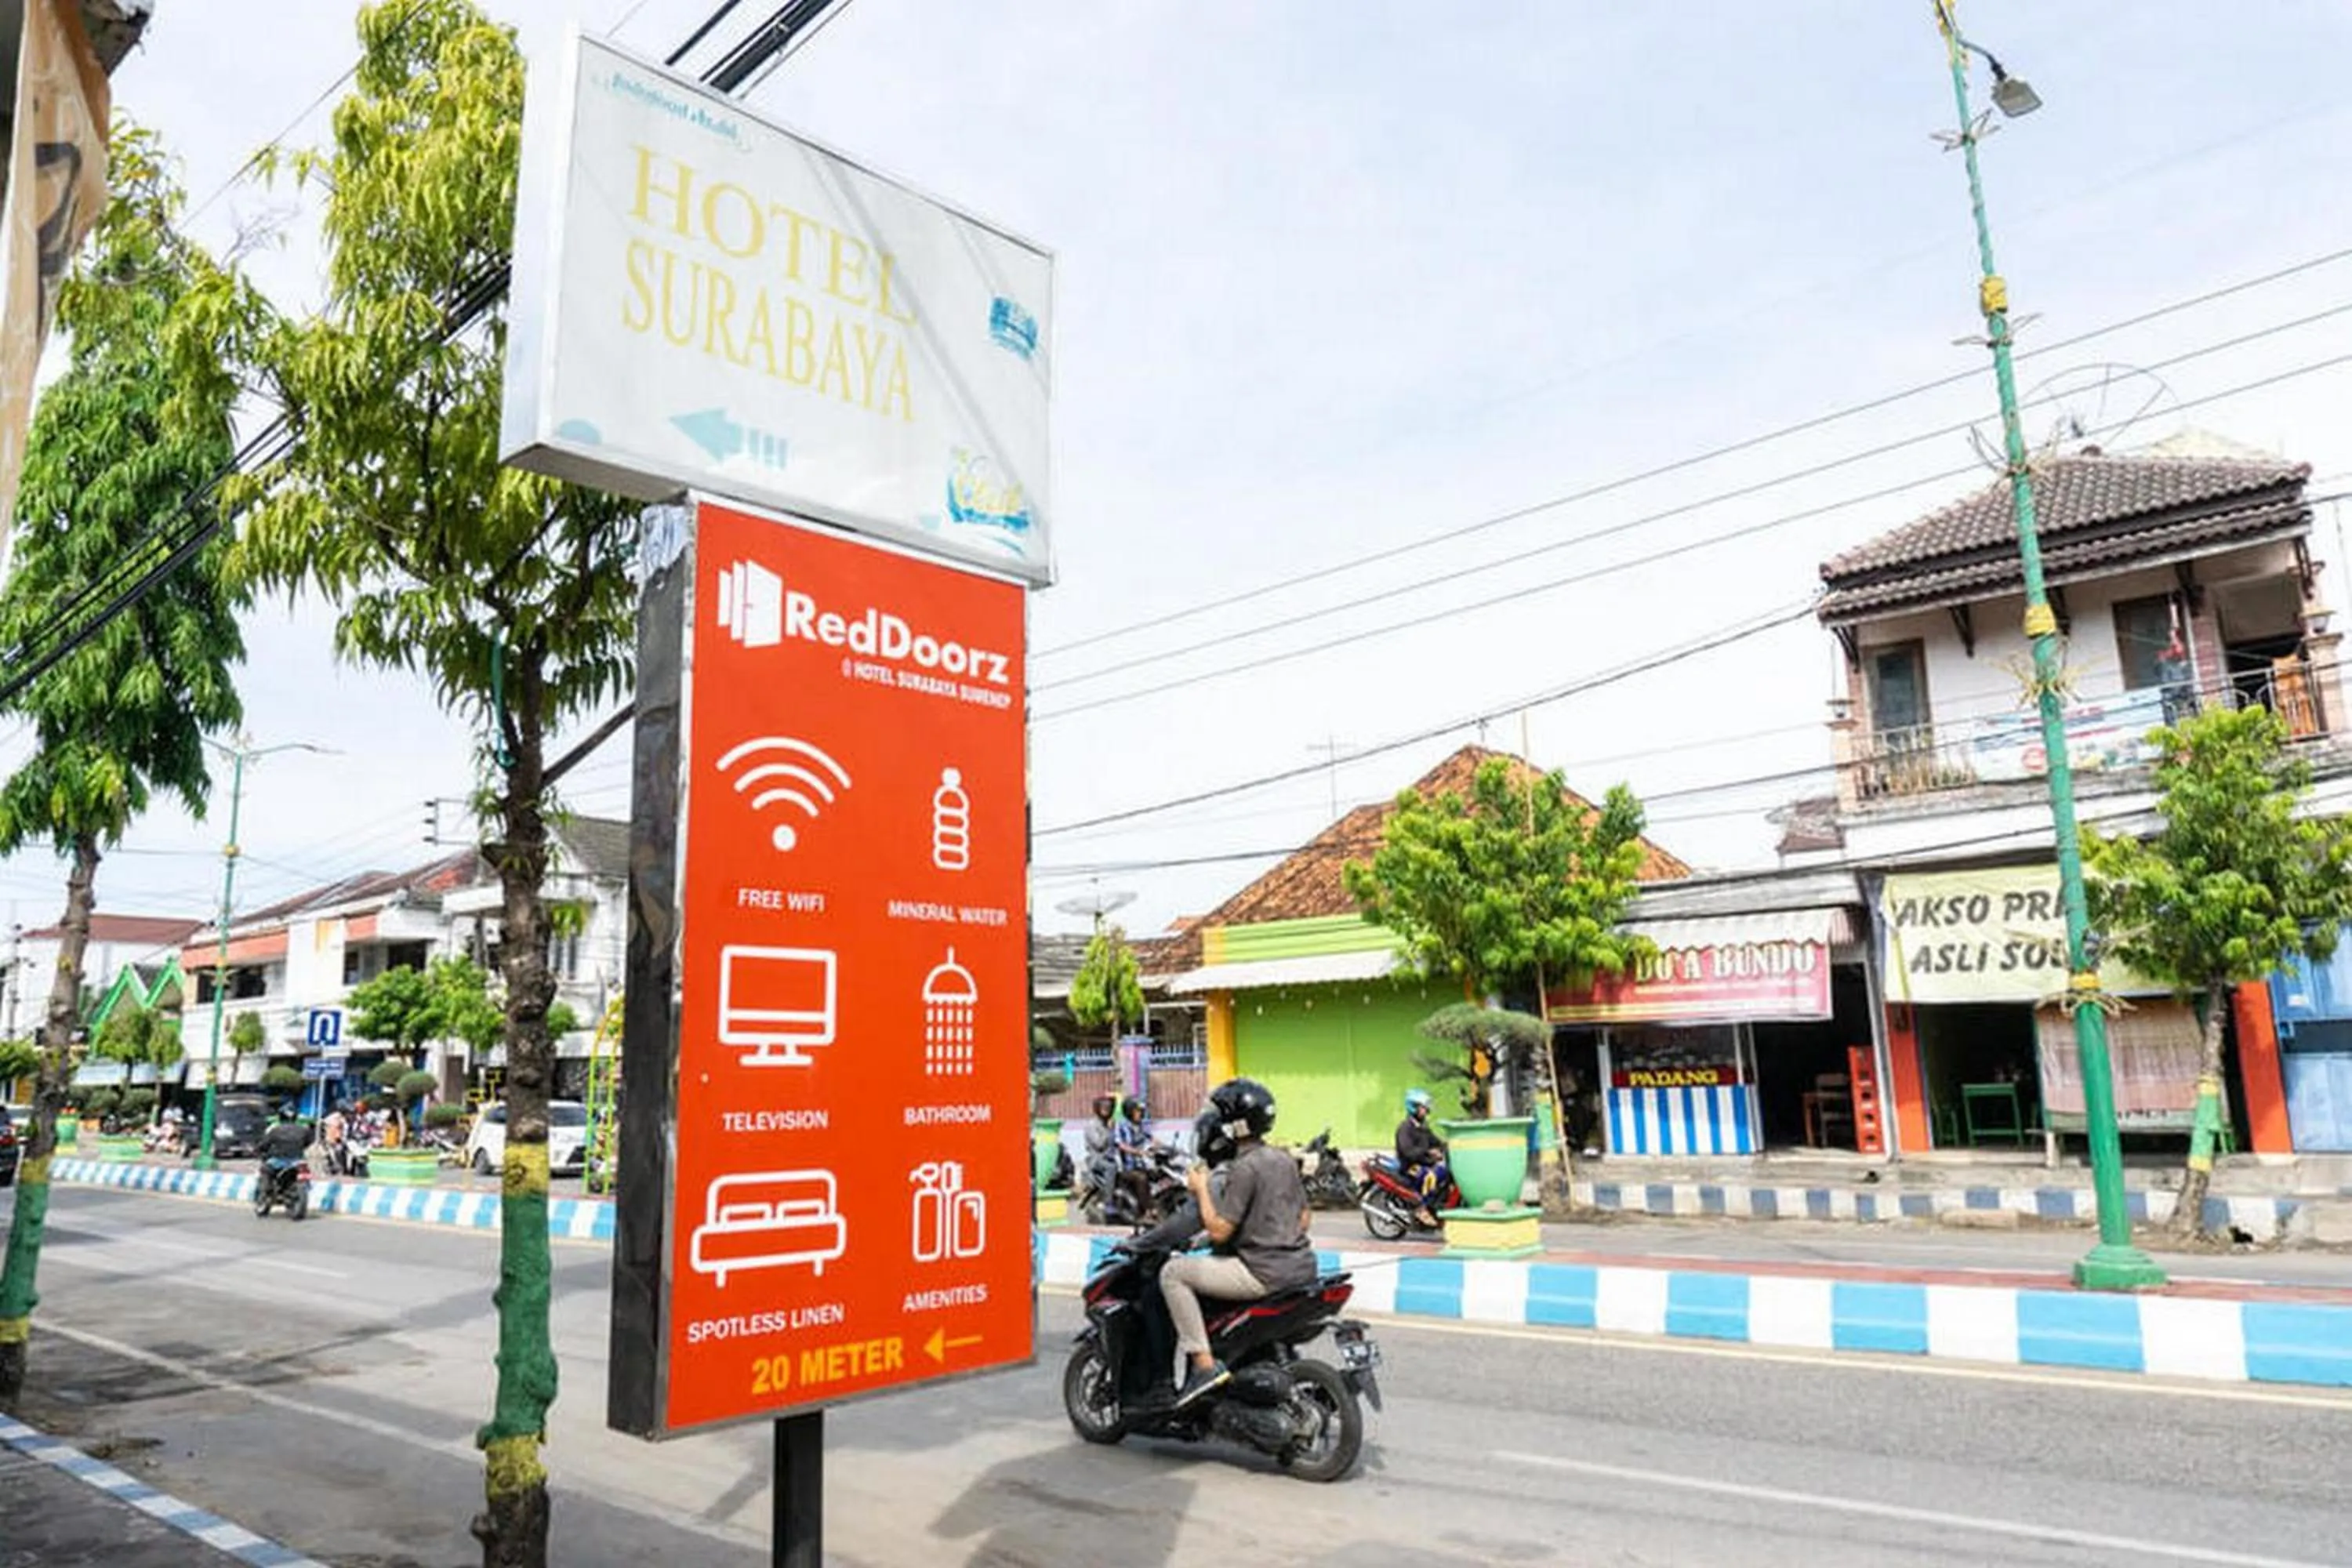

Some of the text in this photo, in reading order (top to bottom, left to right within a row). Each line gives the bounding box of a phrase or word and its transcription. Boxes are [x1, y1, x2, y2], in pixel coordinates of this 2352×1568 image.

[626, 144, 917, 327] HOTEL
[622, 240, 916, 423] SURABAYA
[786, 589, 1010, 684] RedDoorz
[738, 887, 825, 911] FREE WIFI
[888, 901, 1007, 926] MINERAL WATER
[1891, 894, 1991, 928] AKSO
[1910, 942, 1991, 974] ASLI
[1629, 1068, 1719, 1087] PADANG
[722, 1109, 829, 1132] TELEVISION
[904, 1105, 991, 1125] BATHROOM
[903, 1284, 988, 1312] AMENITIES
[688, 1304, 844, 1344] SPOTLESS LINEN
[751, 1336, 903, 1395] 20 METER
